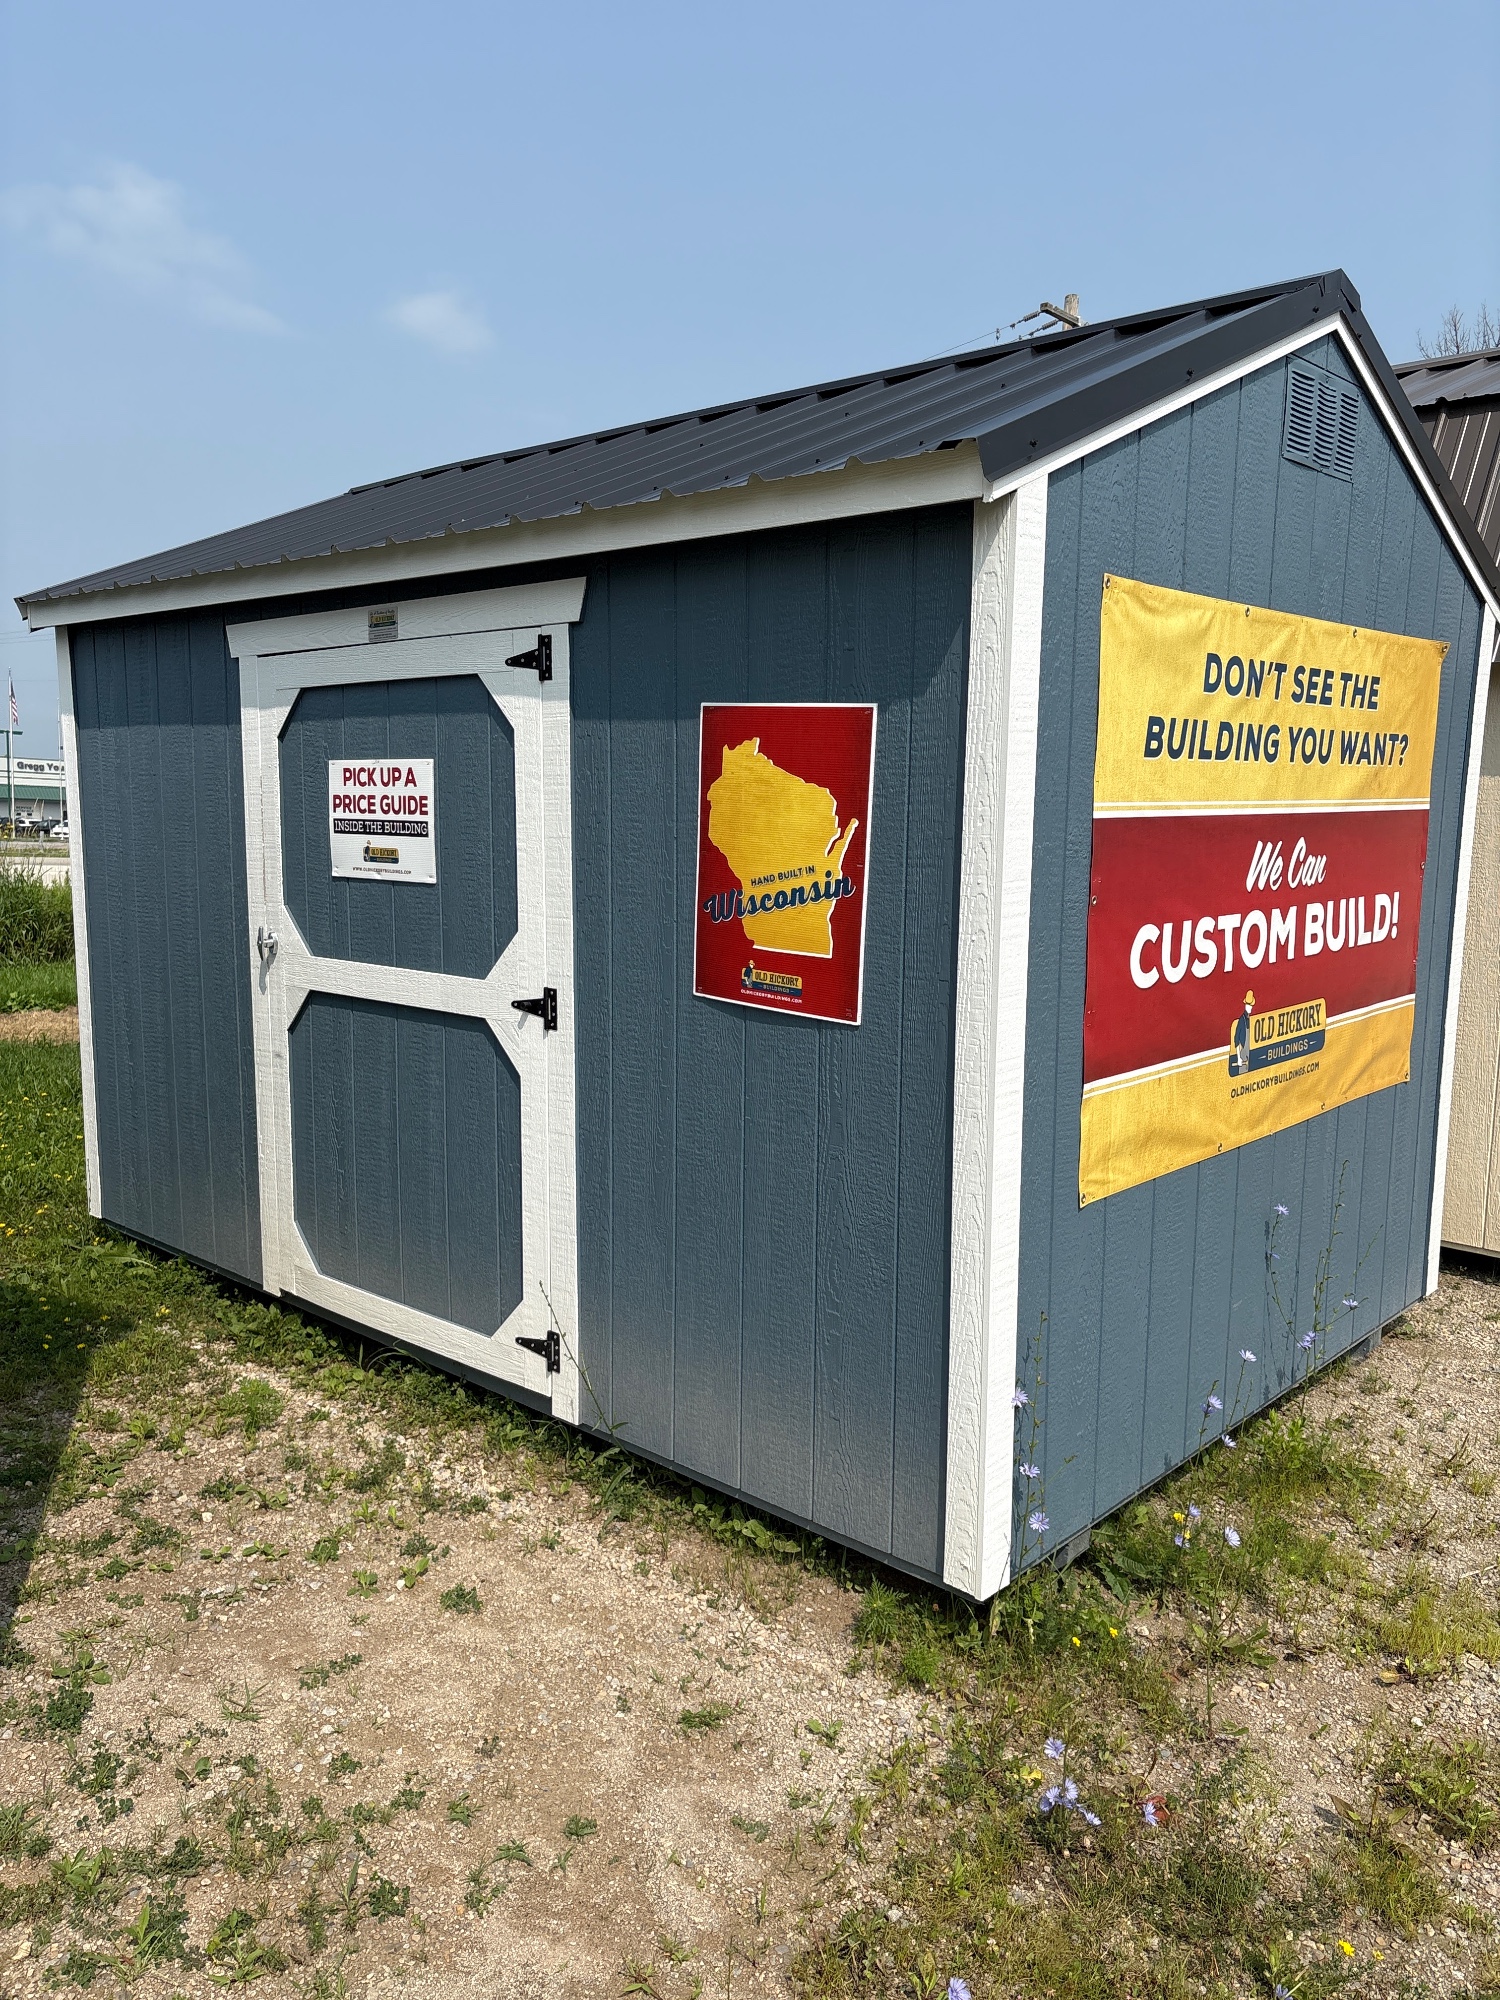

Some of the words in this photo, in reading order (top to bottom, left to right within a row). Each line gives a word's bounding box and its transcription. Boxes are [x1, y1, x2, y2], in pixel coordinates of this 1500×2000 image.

[1203, 653, 1288, 701] DON'T
[1290, 665, 1335, 706] SEE
[1340, 673, 1381, 710] THE
[1143, 716, 1281, 763] BUILDING
[1288, 726, 1335, 765] YOU
[1340, 730, 1409, 767] WANT?
[17, 761, 45, 772] Gregg
[343, 767, 377, 787] PICK
[380, 767, 402, 787] UP
[404, 767, 417, 787] A
[332, 794, 377, 814] PRICE
[380, 795, 429, 816] GUIDE
[334, 820, 364, 832] INSIDE
[365, 821, 383, 833] THE
[384, 822, 428, 835] BUILDING
[750, 875, 776, 887] HAND
[778, 867, 803, 880] BUILT
[805, 865, 816, 875] IN
[1245, 840, 1284, 892] We
[1288, 836, 1327, 889] Can
[703, 870, 856, 923] Wisconsin
[1129, 905, 1298, 989] CUSTOM
[1304, 891, 1400, 957] BUILD!
[754, 971, 768, 982] OLD
[769, 973, 800, 987] HICKORY
[1254, 1015, 1275, 1043] OLD
[1276, 1003, 1322, 1038] HICKORY
[1267, 1039, 1309, 1061] BUILDINGS
[1230, 1061, 1320, 1098] OLDHICKORYBUILDINGS.COM
